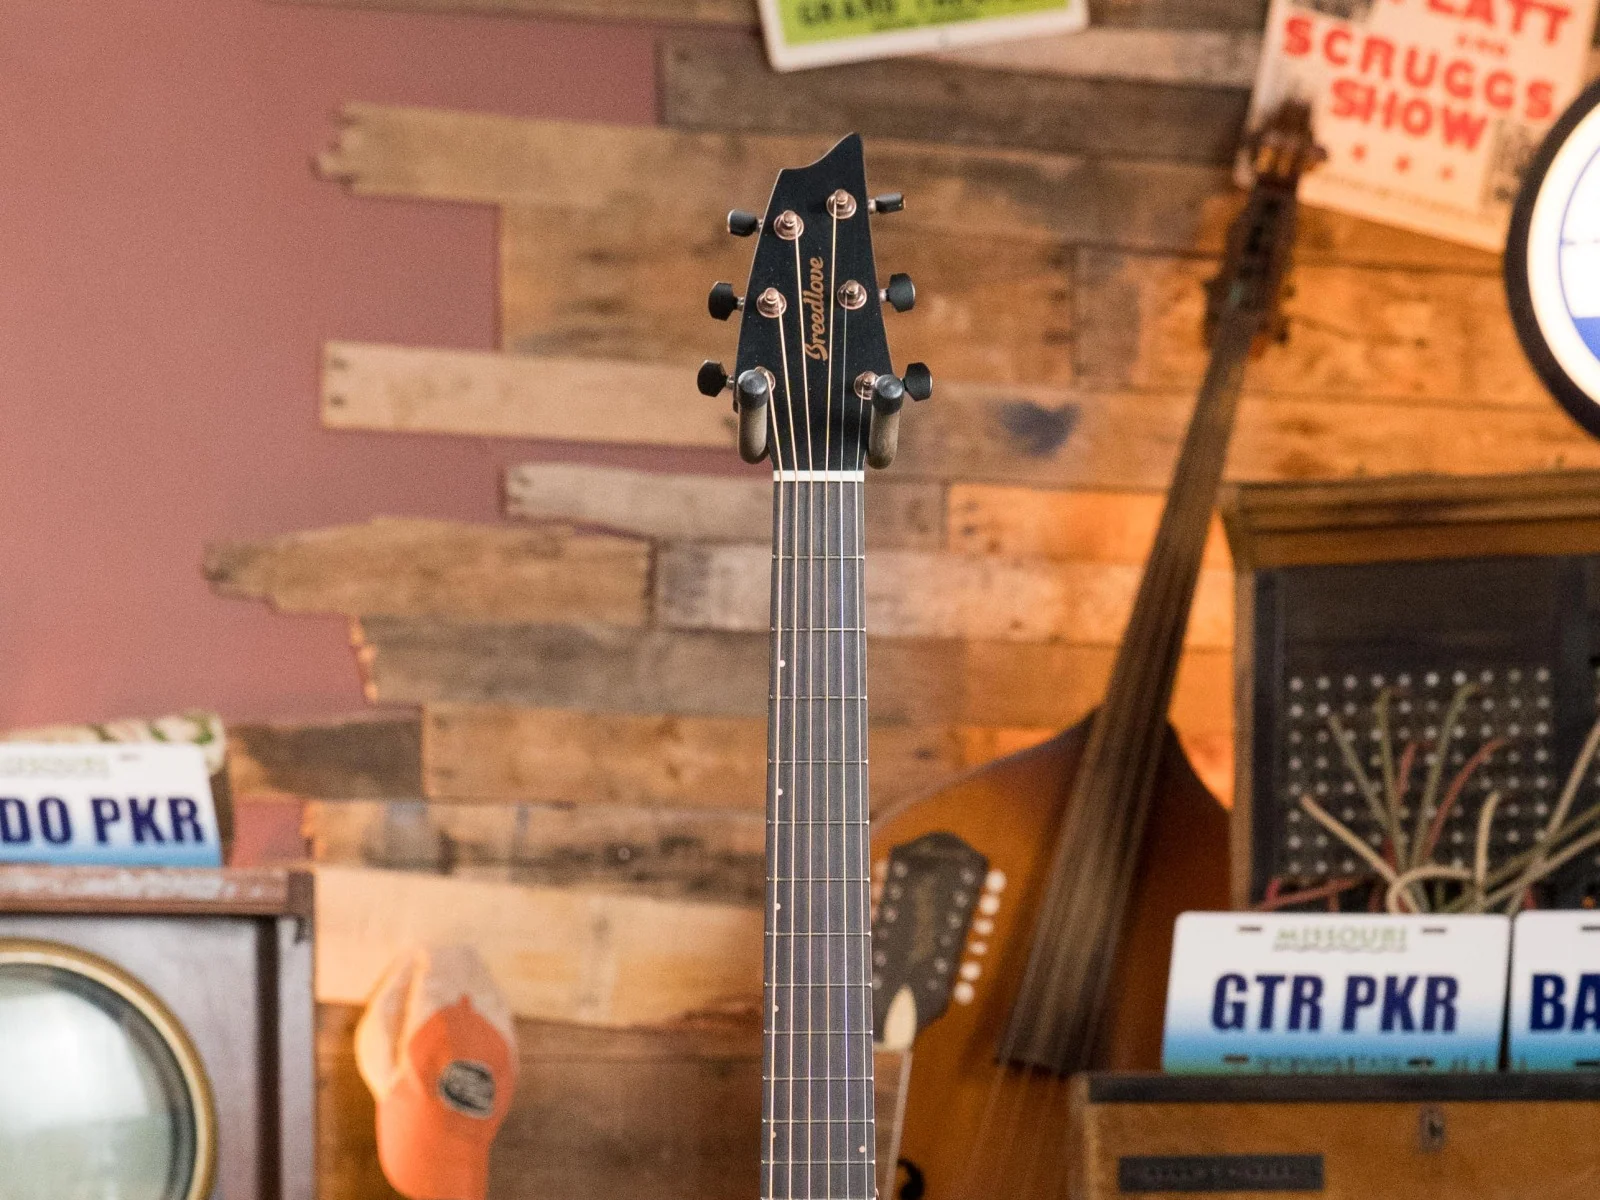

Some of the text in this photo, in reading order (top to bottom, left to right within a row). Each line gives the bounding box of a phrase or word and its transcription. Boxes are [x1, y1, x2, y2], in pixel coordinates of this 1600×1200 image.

[1282, 15, 1555, 121] SCRUGGS
[1330, 77, 1489, 152] SHOW
[805, 255, 828, 362] Breedlove
[90, 796, 205, 845] PKR
[1273, 925, 1408, 951] MISSOURI
[1210, 972, 1459, 1034] GTR PKR
